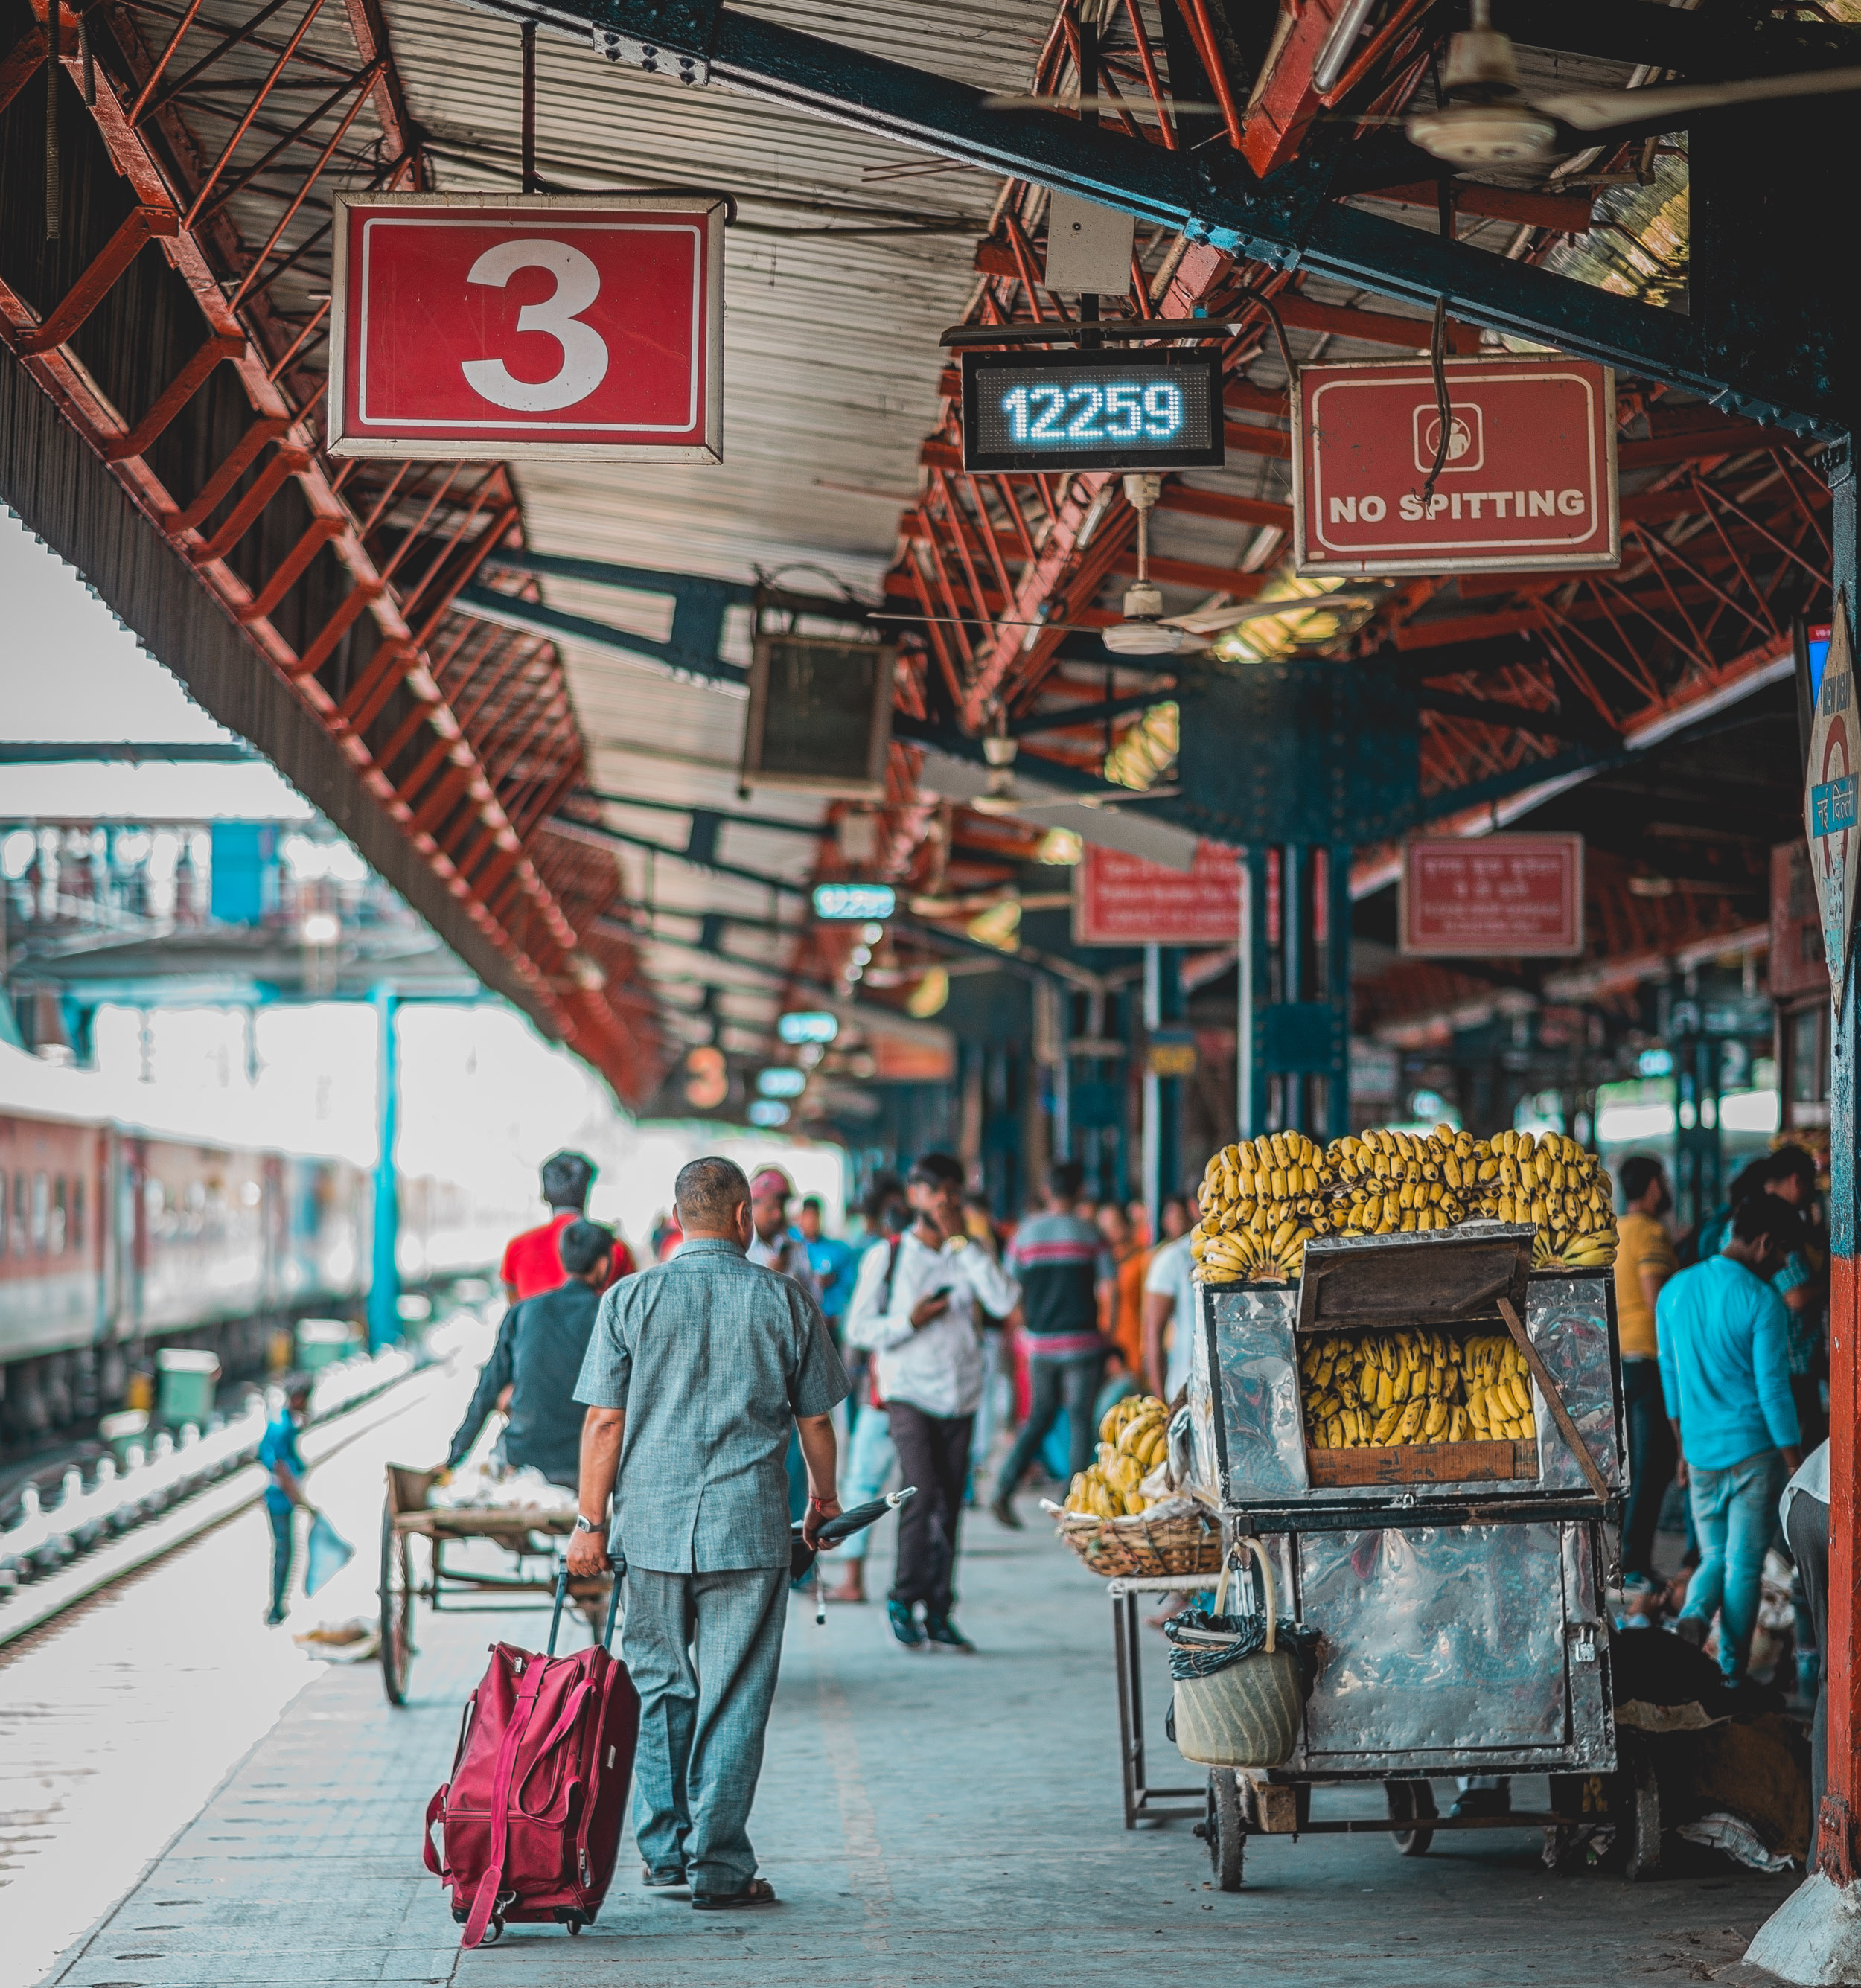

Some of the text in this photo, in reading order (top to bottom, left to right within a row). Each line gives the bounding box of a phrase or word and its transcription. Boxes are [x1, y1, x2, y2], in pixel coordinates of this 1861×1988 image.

[461, 238, 609, 412] 3
[1004, 385, 1181, 439] 12259
[1329, 489, 1586, 524] NO SPITTING
[1817, 779, 1854, 831] नई दिल्ली
